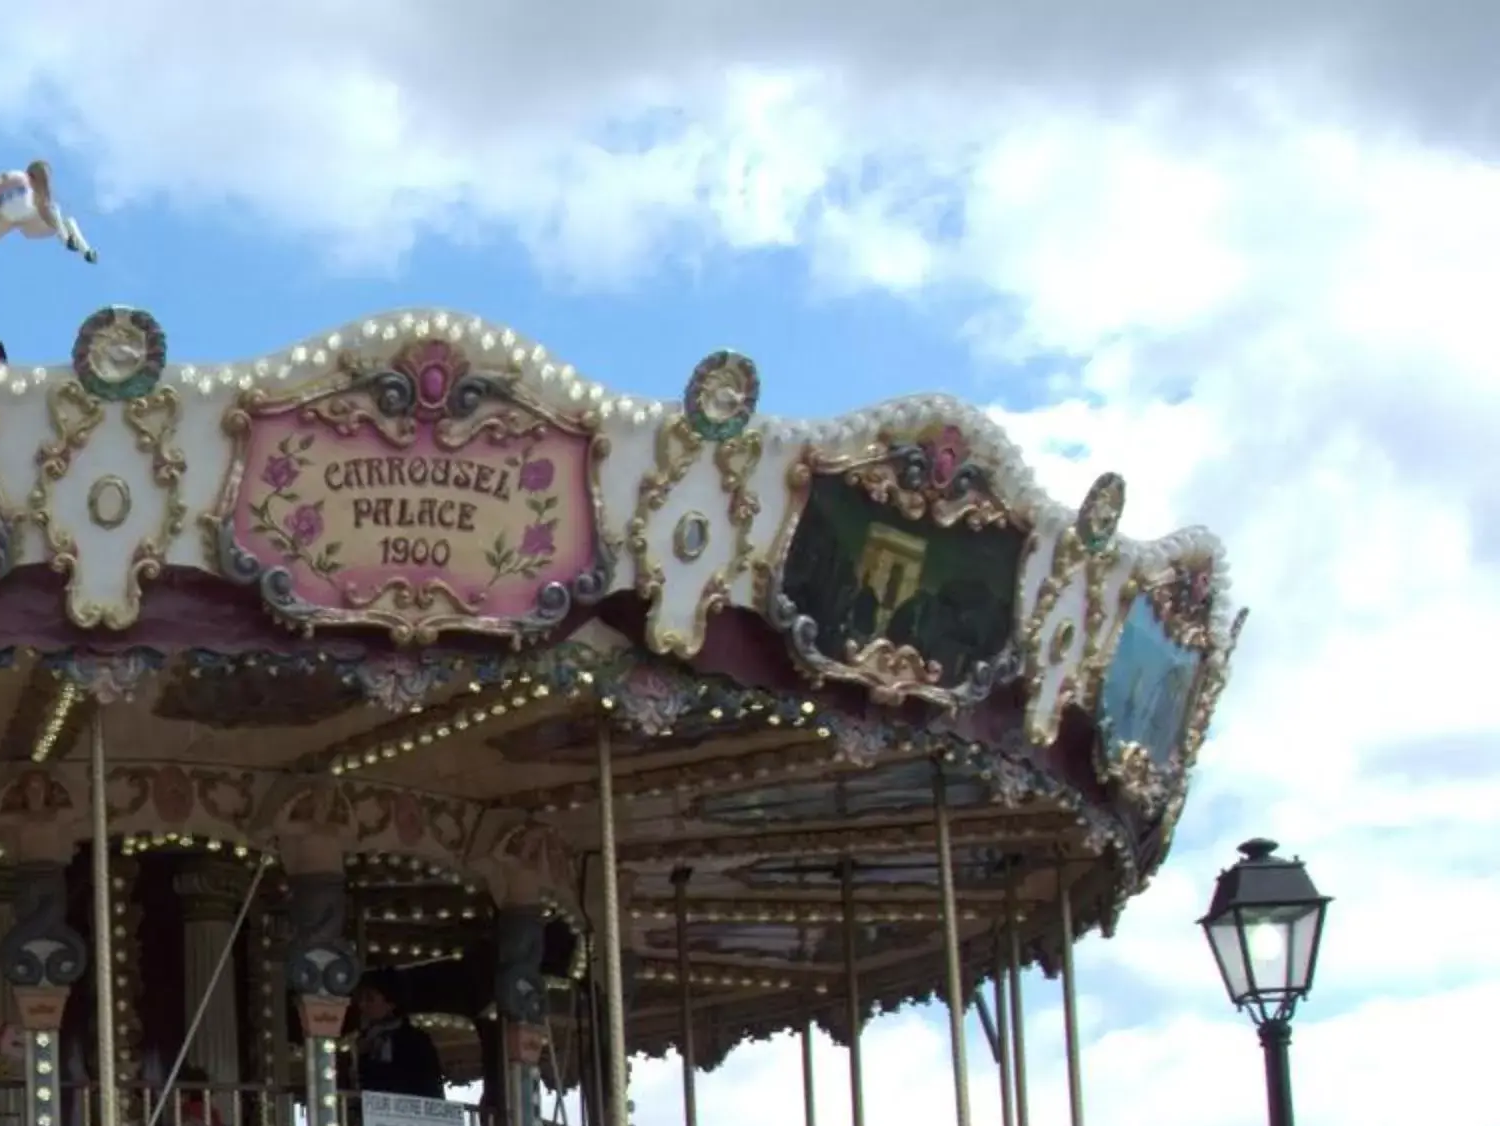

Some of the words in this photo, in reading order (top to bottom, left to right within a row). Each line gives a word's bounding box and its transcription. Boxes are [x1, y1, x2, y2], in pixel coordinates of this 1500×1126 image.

[324, 456, 509, 501] CARROUSEL
[353, 498, 478, 532] PALACE
[381, 537, 451, 566] 1900
